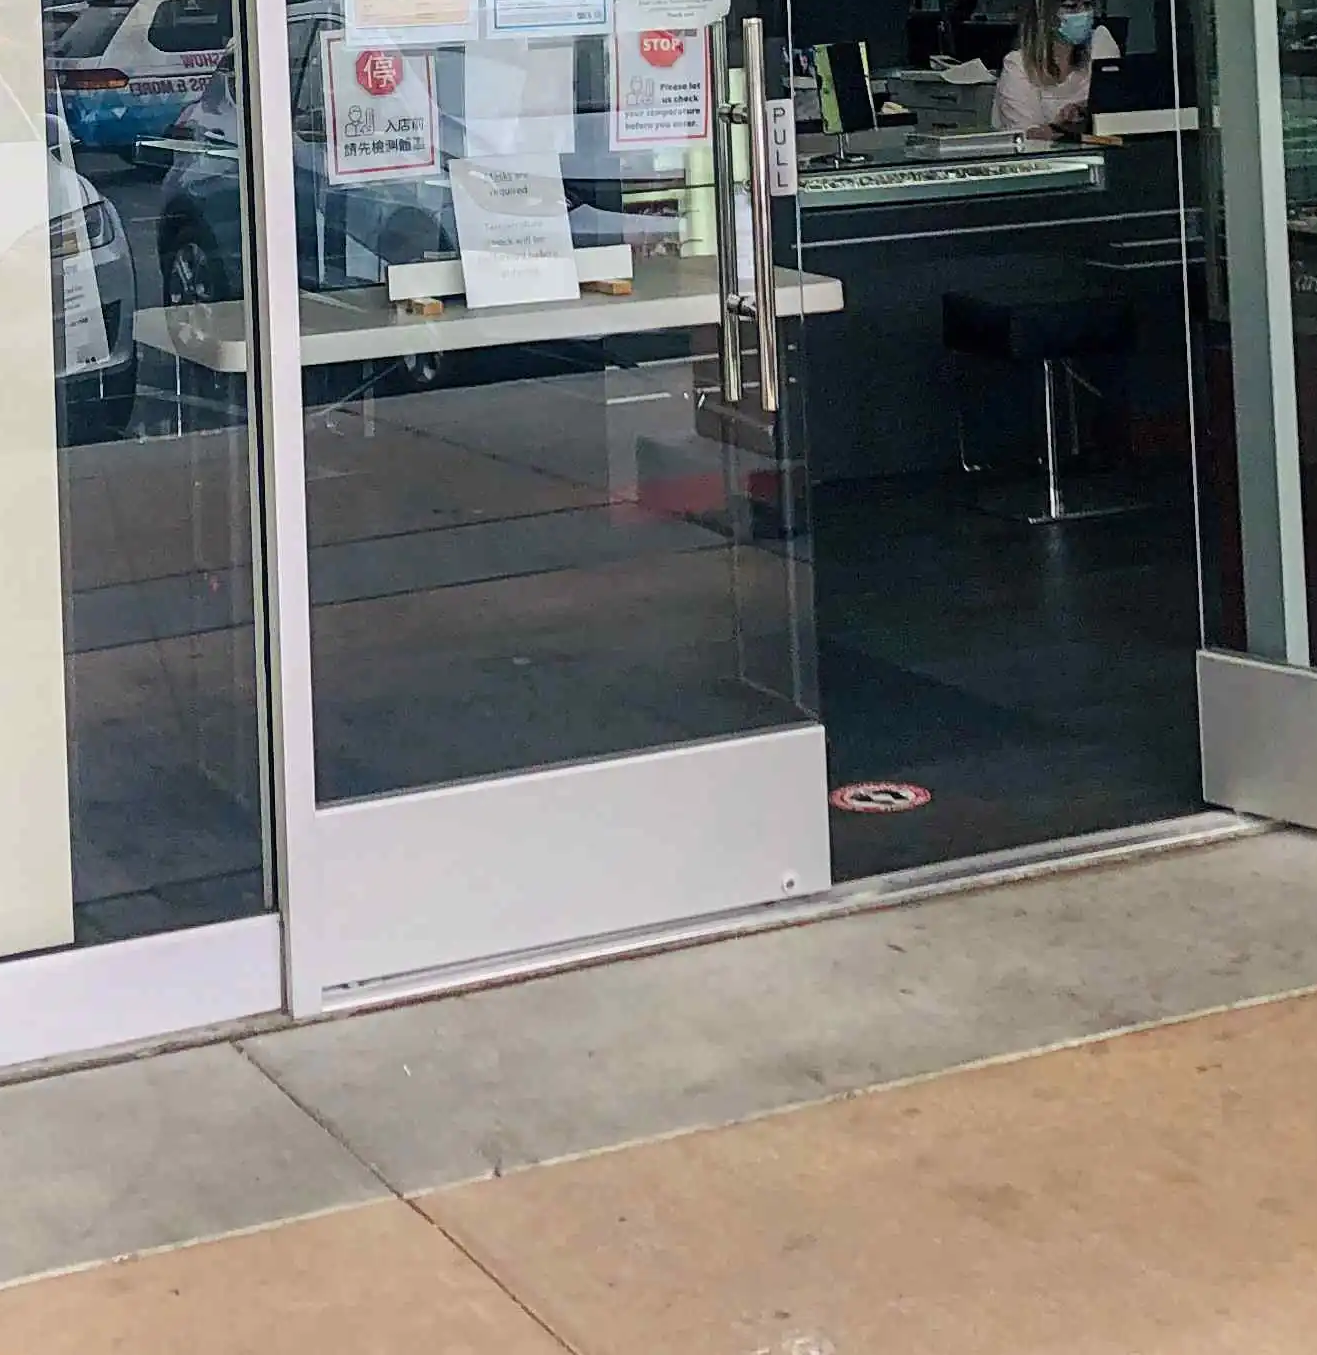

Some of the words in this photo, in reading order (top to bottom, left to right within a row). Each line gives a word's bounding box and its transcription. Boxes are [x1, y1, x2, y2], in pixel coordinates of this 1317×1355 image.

[643, 38, 682, 52] STOP
[364, 51, 397, 88] 停
[660, 83, 688, 91] Please
[689, 82, 701, 90] let
[674, 95, 699, 103] check
[773, 107, 789, 188] PULL
